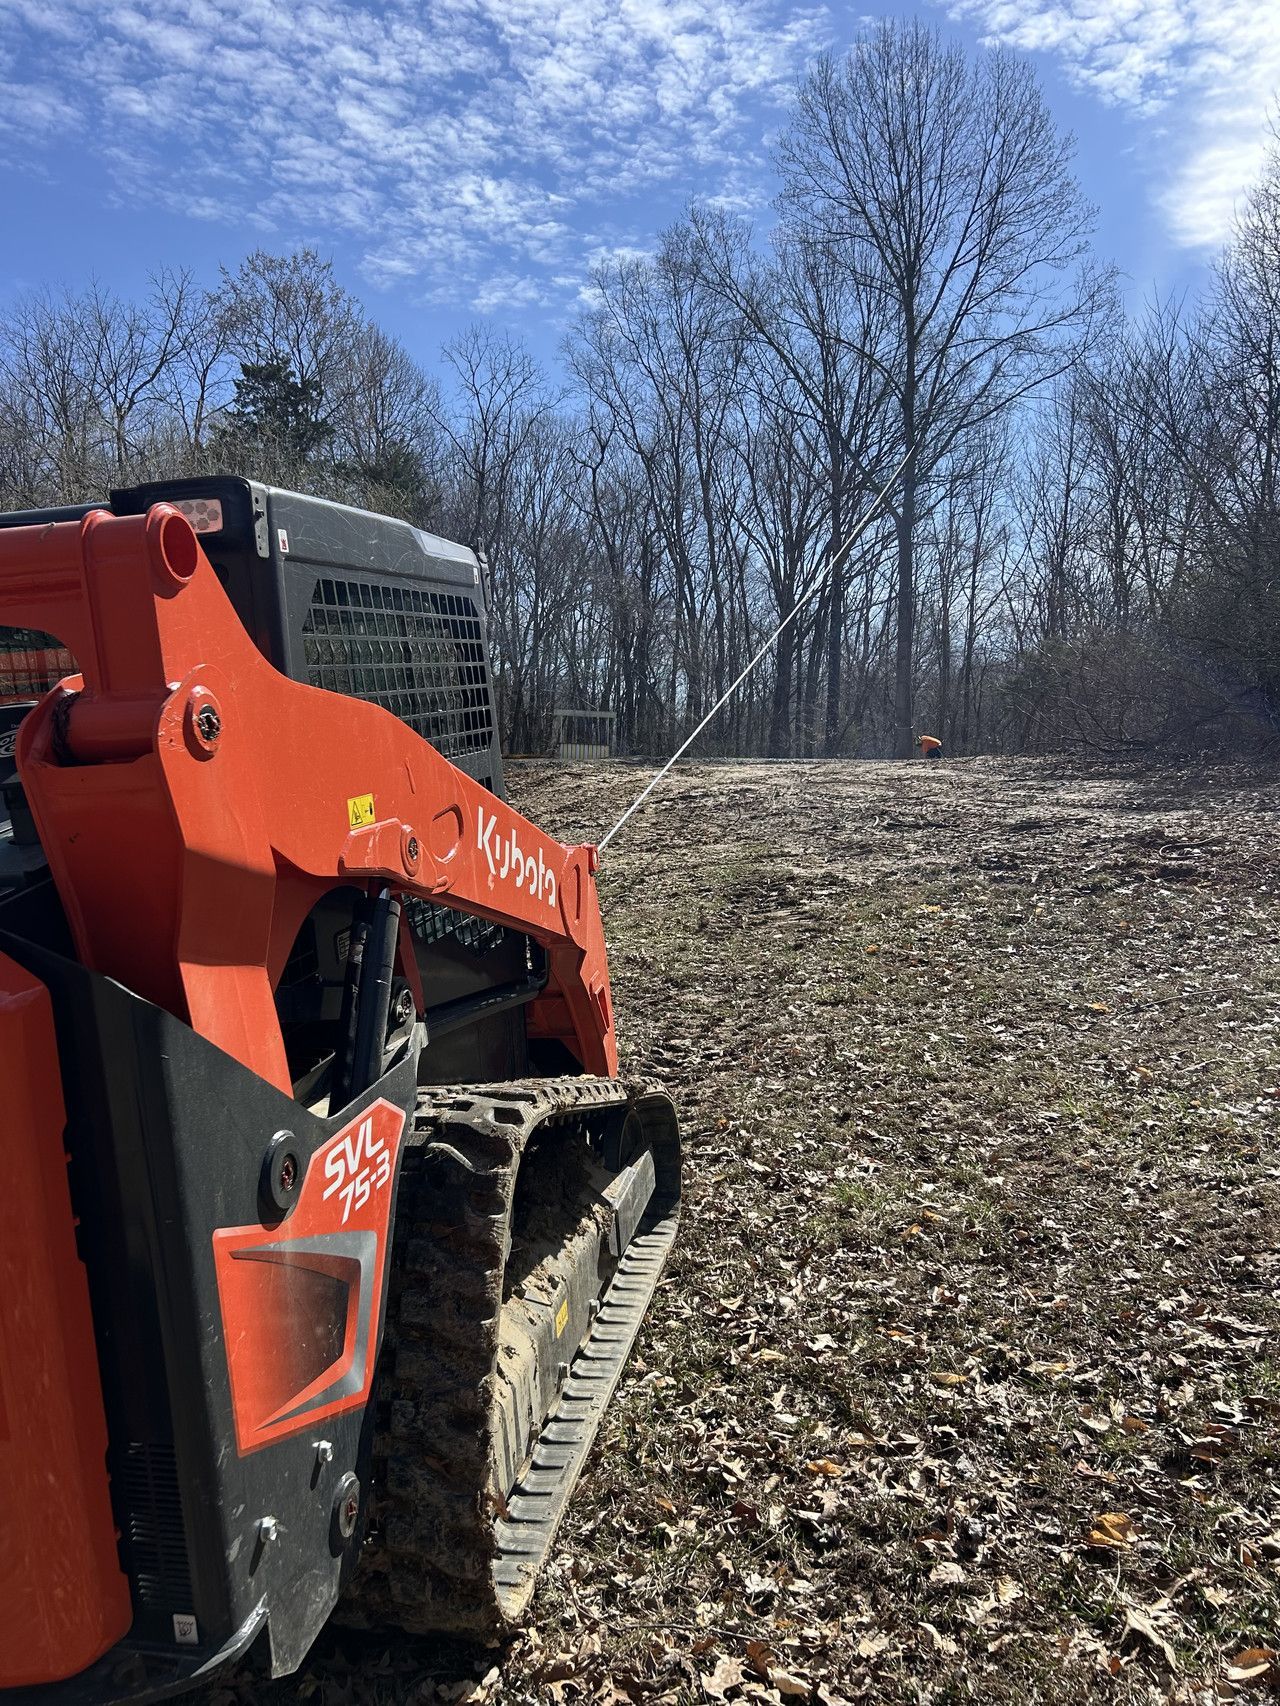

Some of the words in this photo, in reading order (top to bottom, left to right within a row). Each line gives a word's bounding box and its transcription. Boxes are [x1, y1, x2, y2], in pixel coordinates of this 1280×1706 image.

[477, 805, 556, 908] Kubota
[323, 1116, 385, 1201] SVL
[339, 1149, 391, 1225] 75-3
